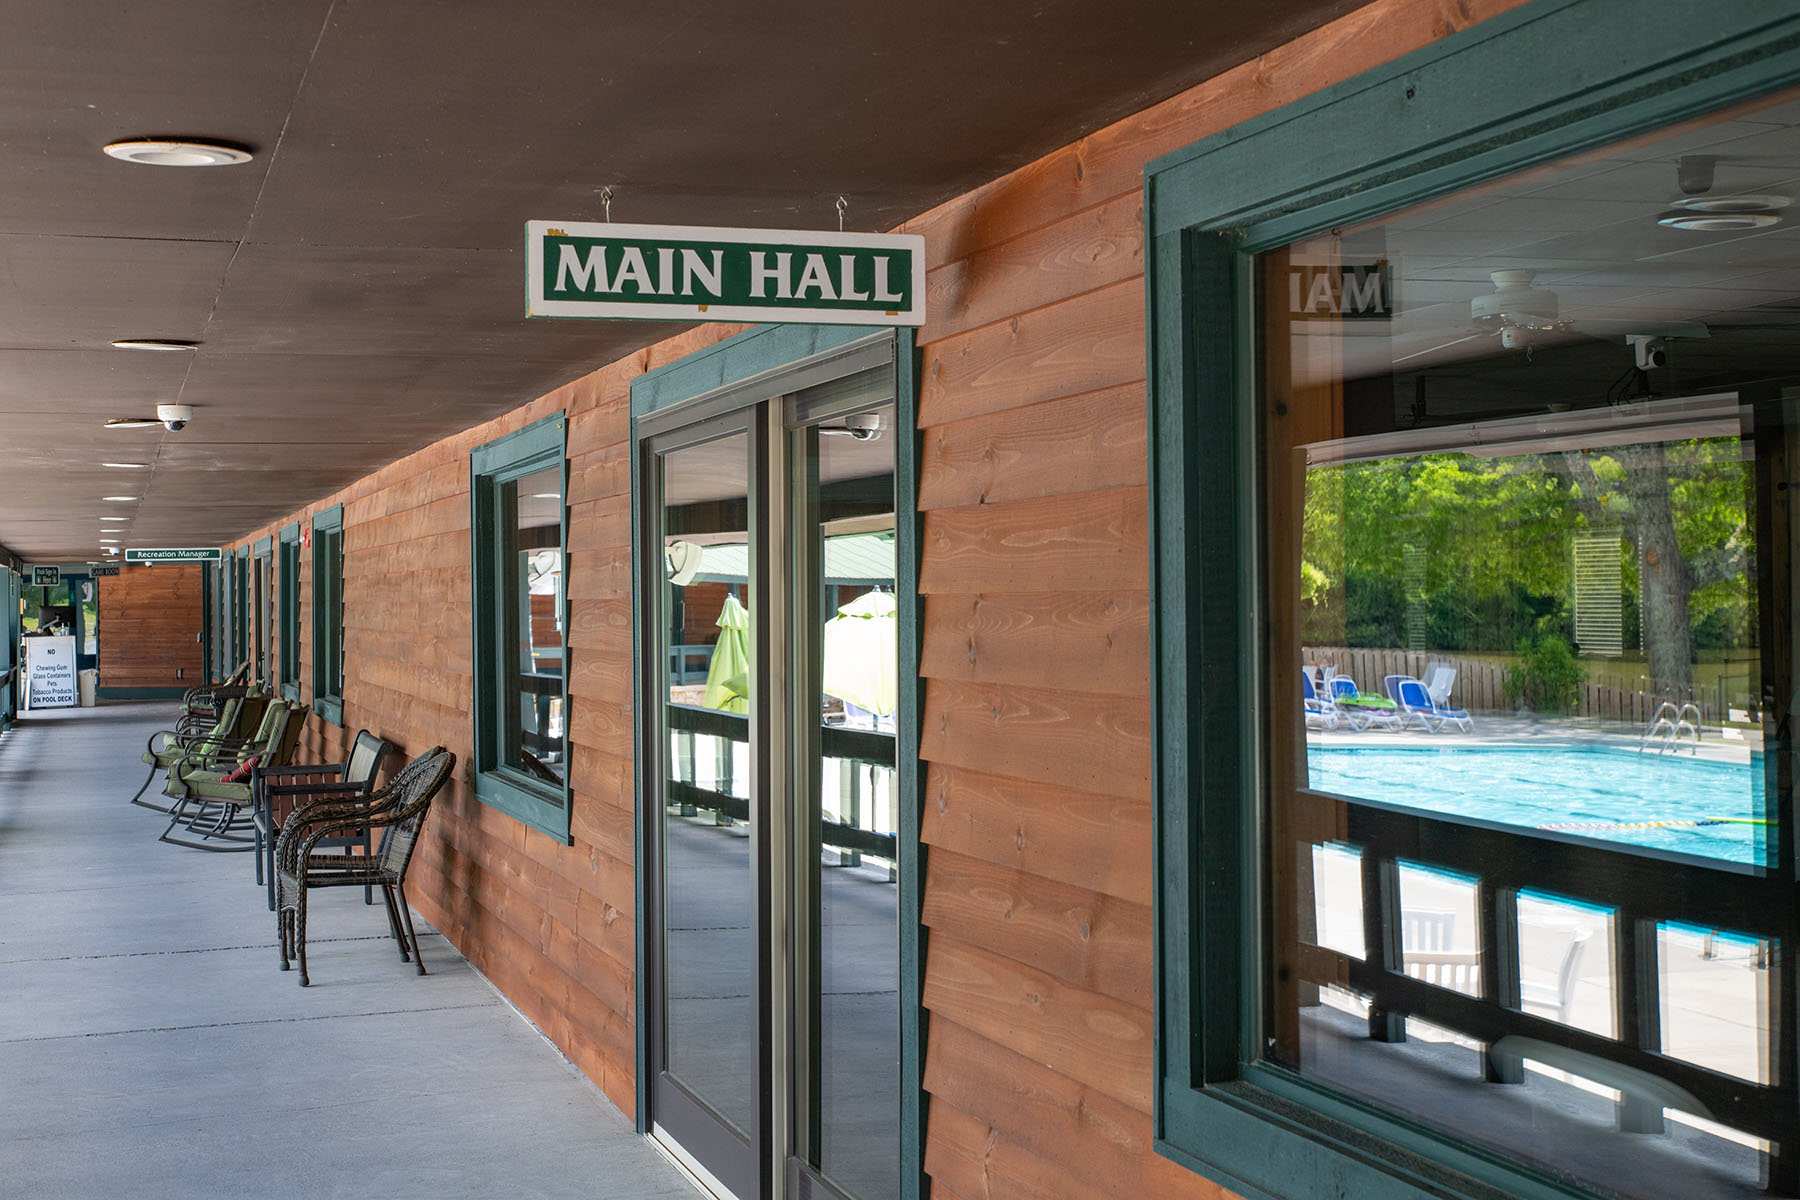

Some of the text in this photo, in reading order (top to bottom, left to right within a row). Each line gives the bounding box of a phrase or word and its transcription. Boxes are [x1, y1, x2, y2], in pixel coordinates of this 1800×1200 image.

[554, 243, 903, 302] MAIN HALL
[177, 550, 210, 559] Manager
[105, 567, 120, 576] ROOM
